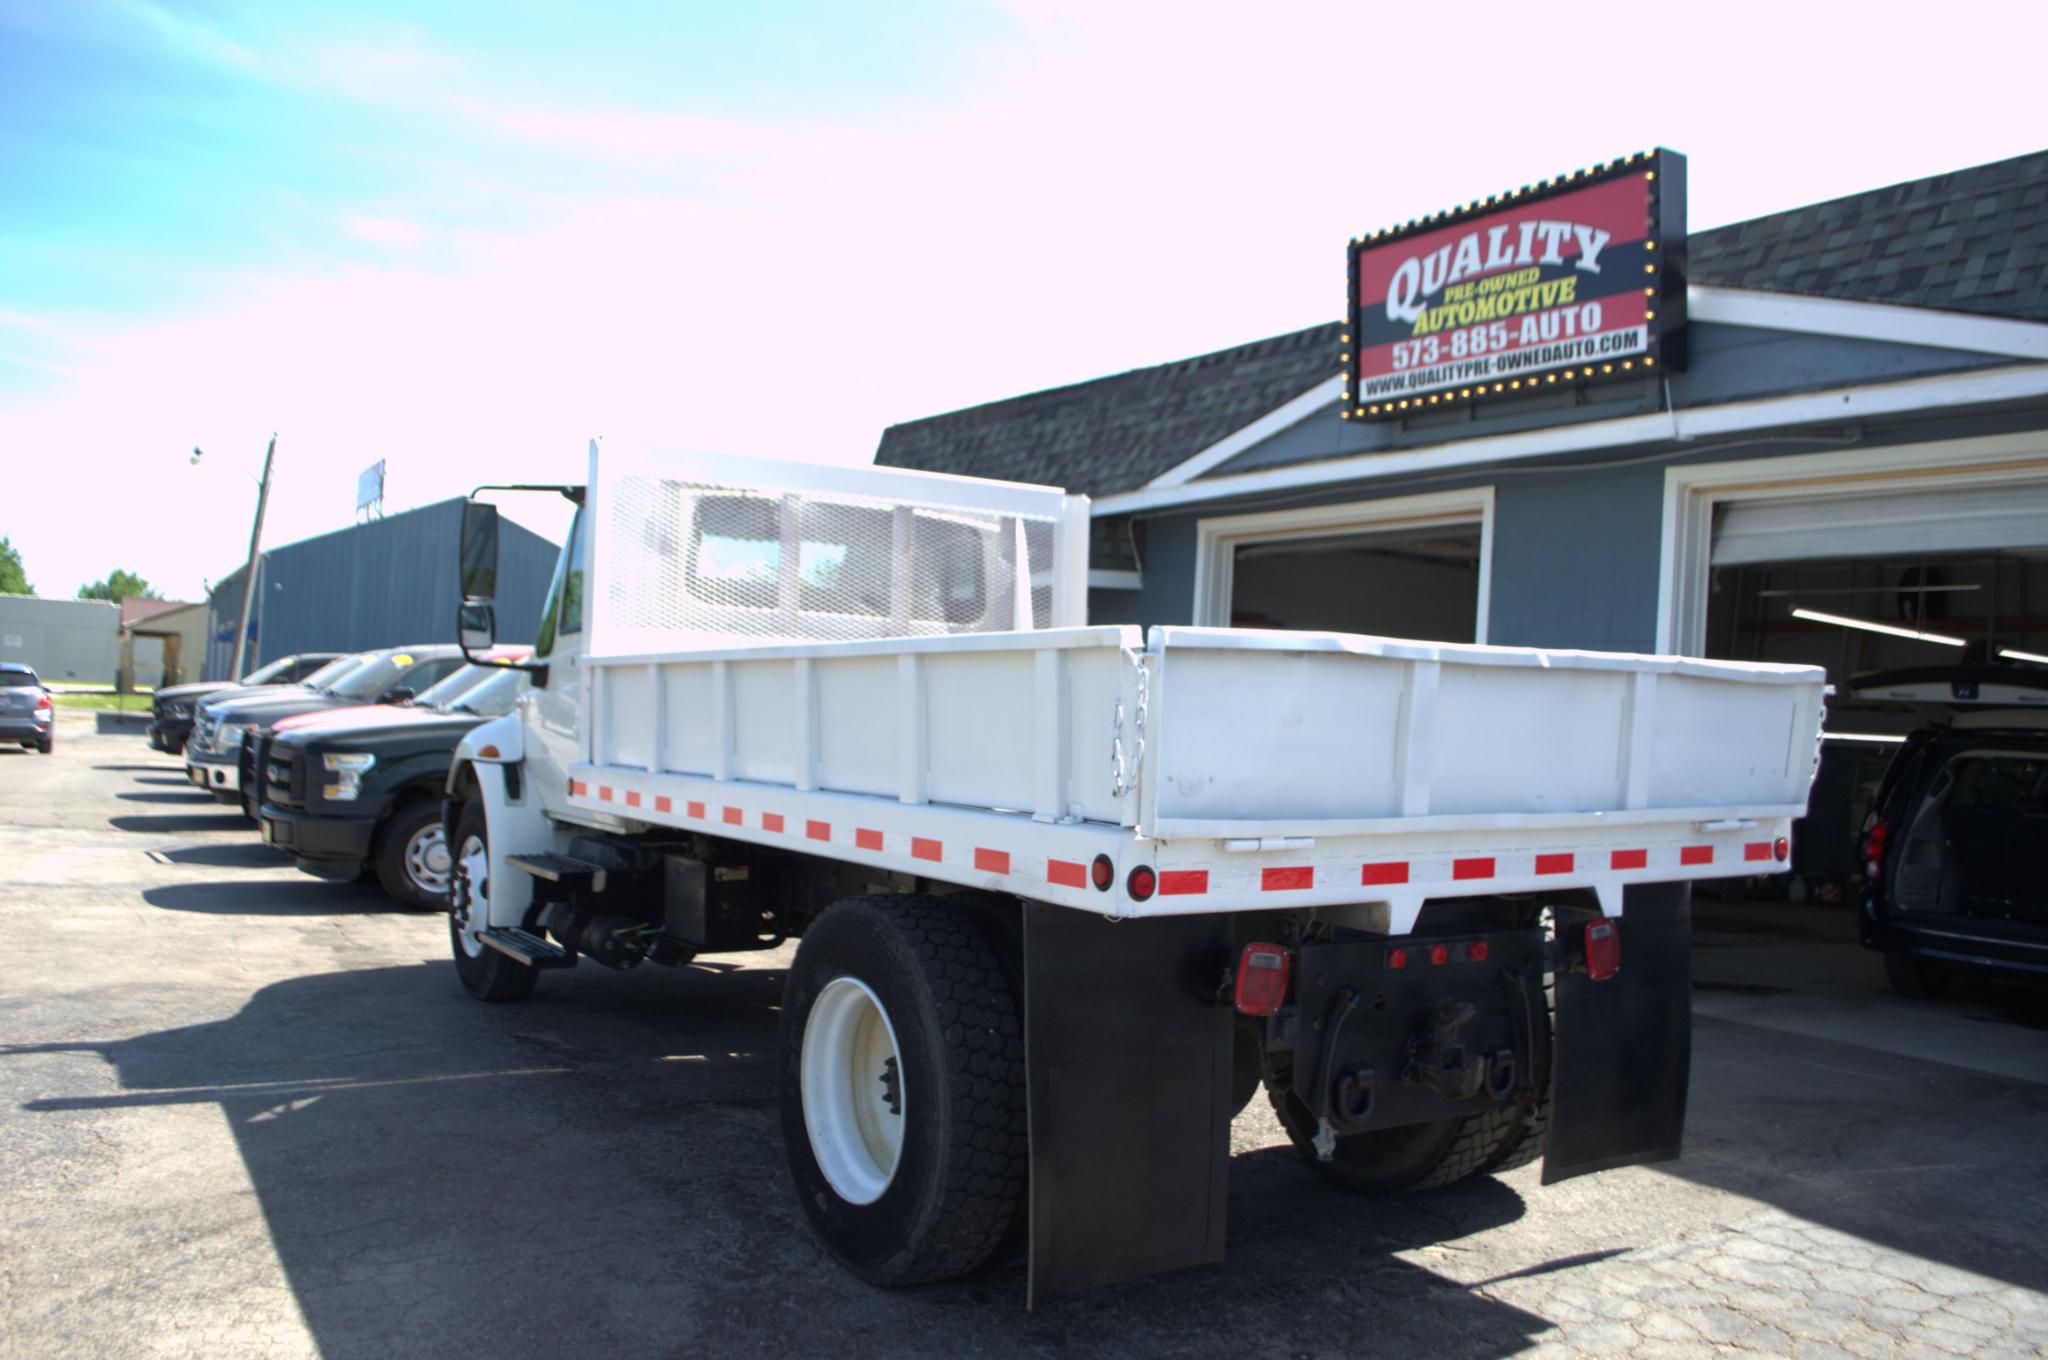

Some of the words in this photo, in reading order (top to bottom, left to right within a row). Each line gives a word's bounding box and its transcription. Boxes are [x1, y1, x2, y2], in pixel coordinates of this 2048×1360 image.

[1386, 220, 1611, 322] QUALITY
[1444, 266, 1541, 304] PRE-OWNED
[1392, 302, 1602, 370] 573-885-AUTO
[1412, 275, 1577, 336] AUTOMOTIVE
[1366, 331, 1639, 396] WWW.QUALITYPRE-OWNEDAUTO.COM
